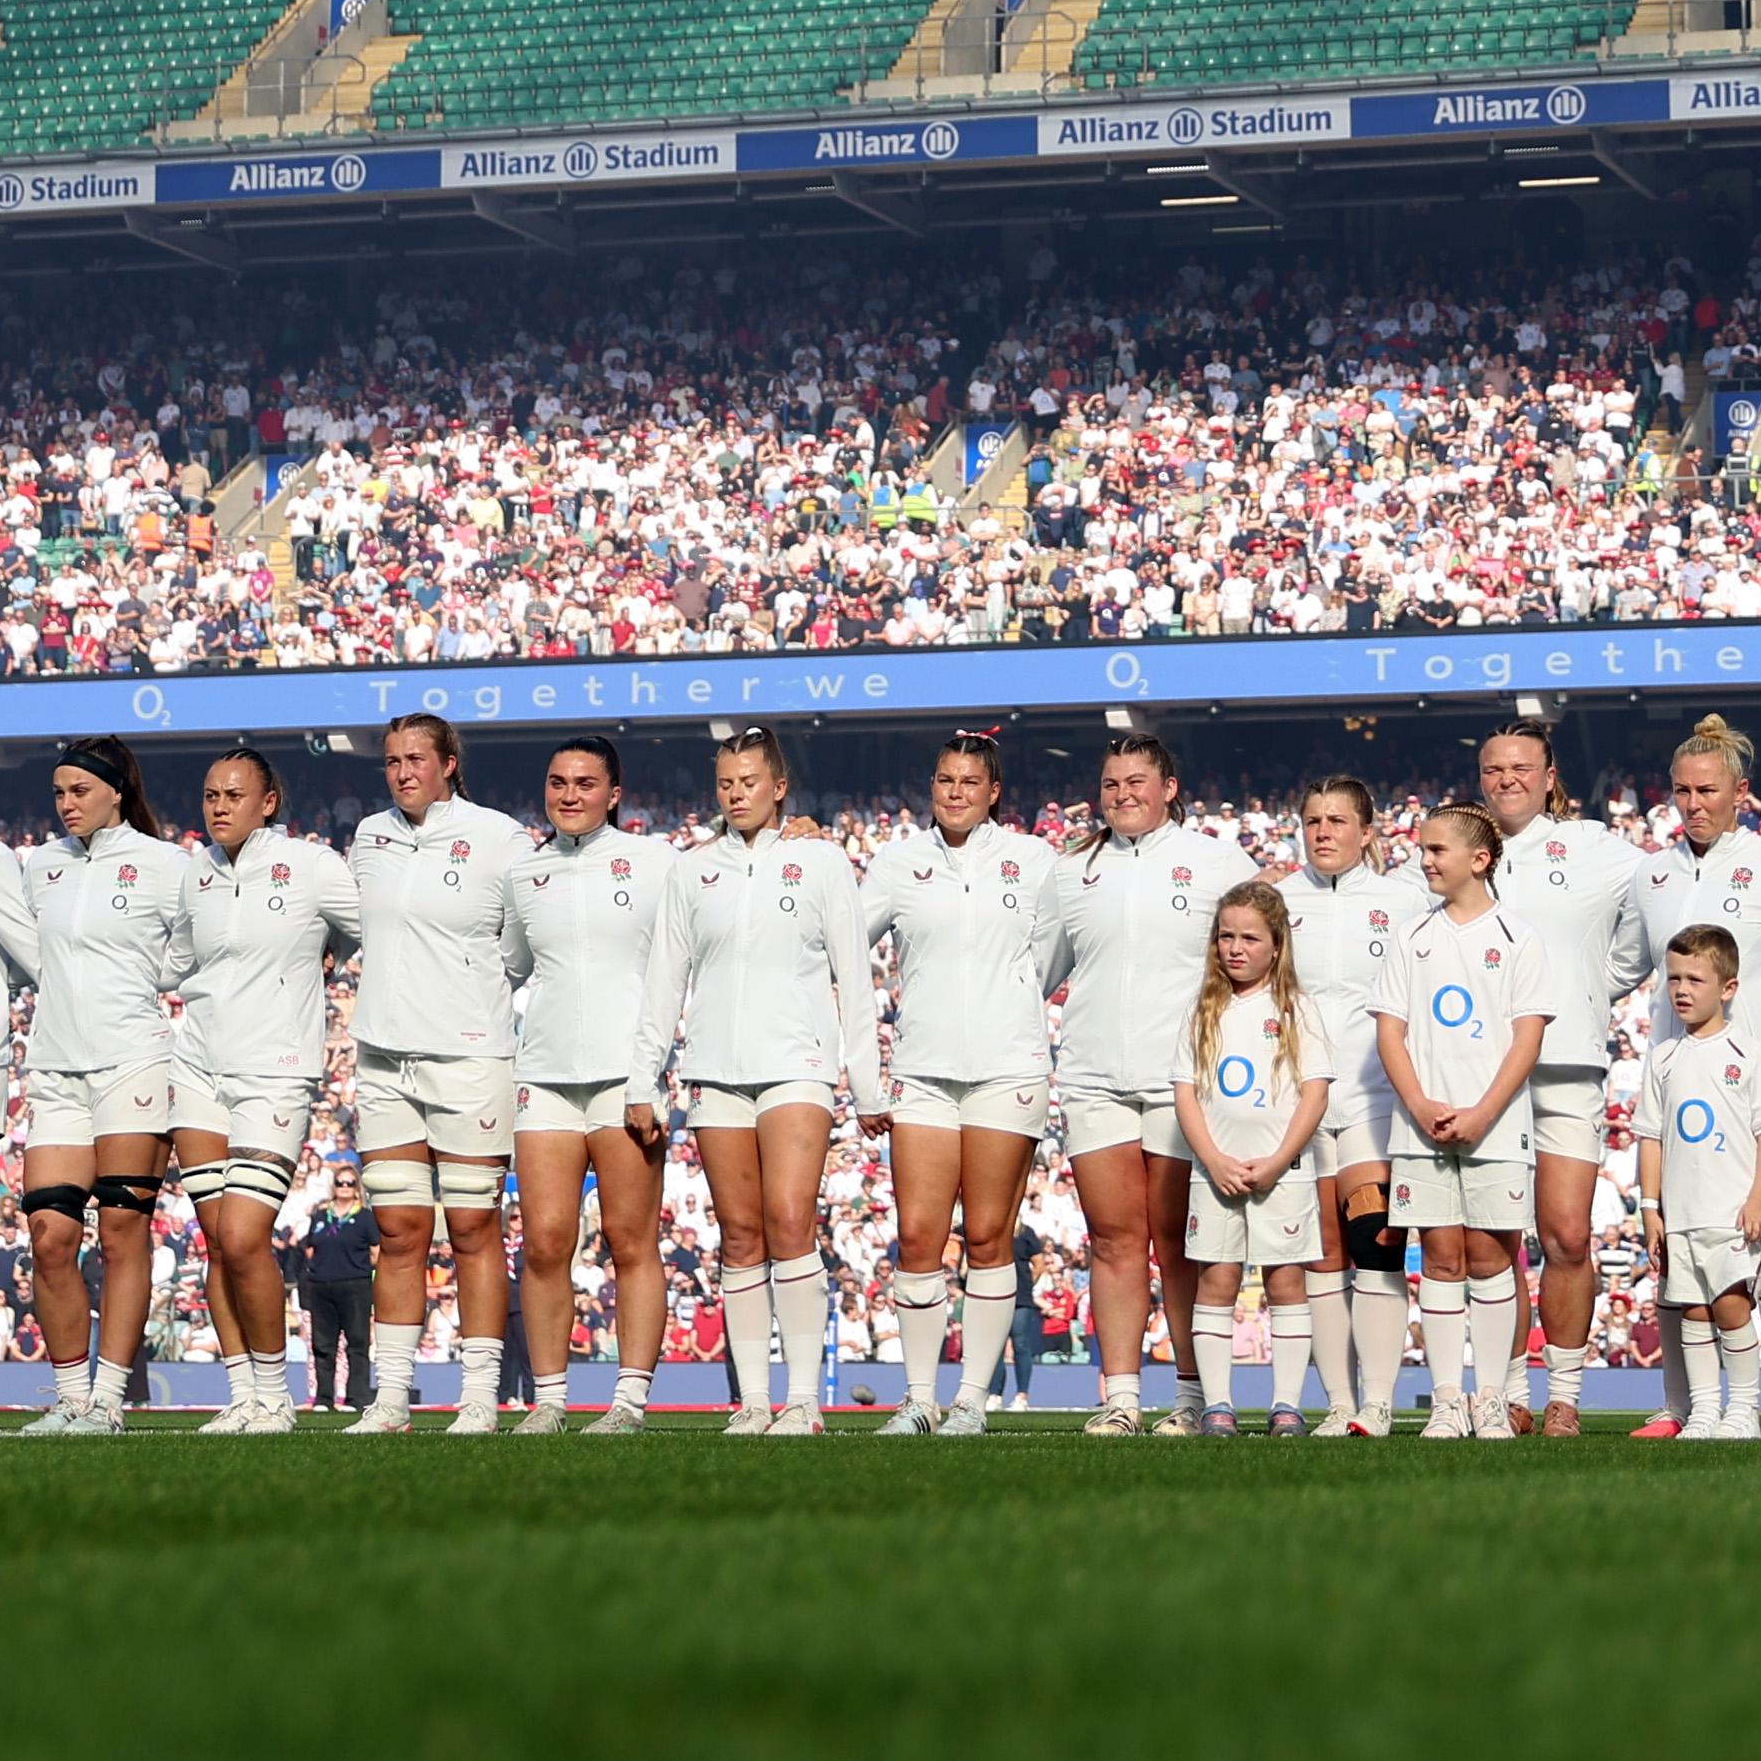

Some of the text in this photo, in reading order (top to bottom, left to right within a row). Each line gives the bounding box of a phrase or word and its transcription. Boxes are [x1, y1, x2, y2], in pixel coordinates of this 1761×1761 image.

[1434, 96, 1540, 125] Allianz
[1058, 107, 1332, 145] Allianz Stadium
[460, 141, 719, 179] Allianz Stadium
[815, 131, 915, 159] Allianz
[30, 172, 139, 203] Stadium
[230, 164, 325, 192] Allianz
[369, 672, 889, 717] Together we
[277, 1055, 300, 1066] ASB
